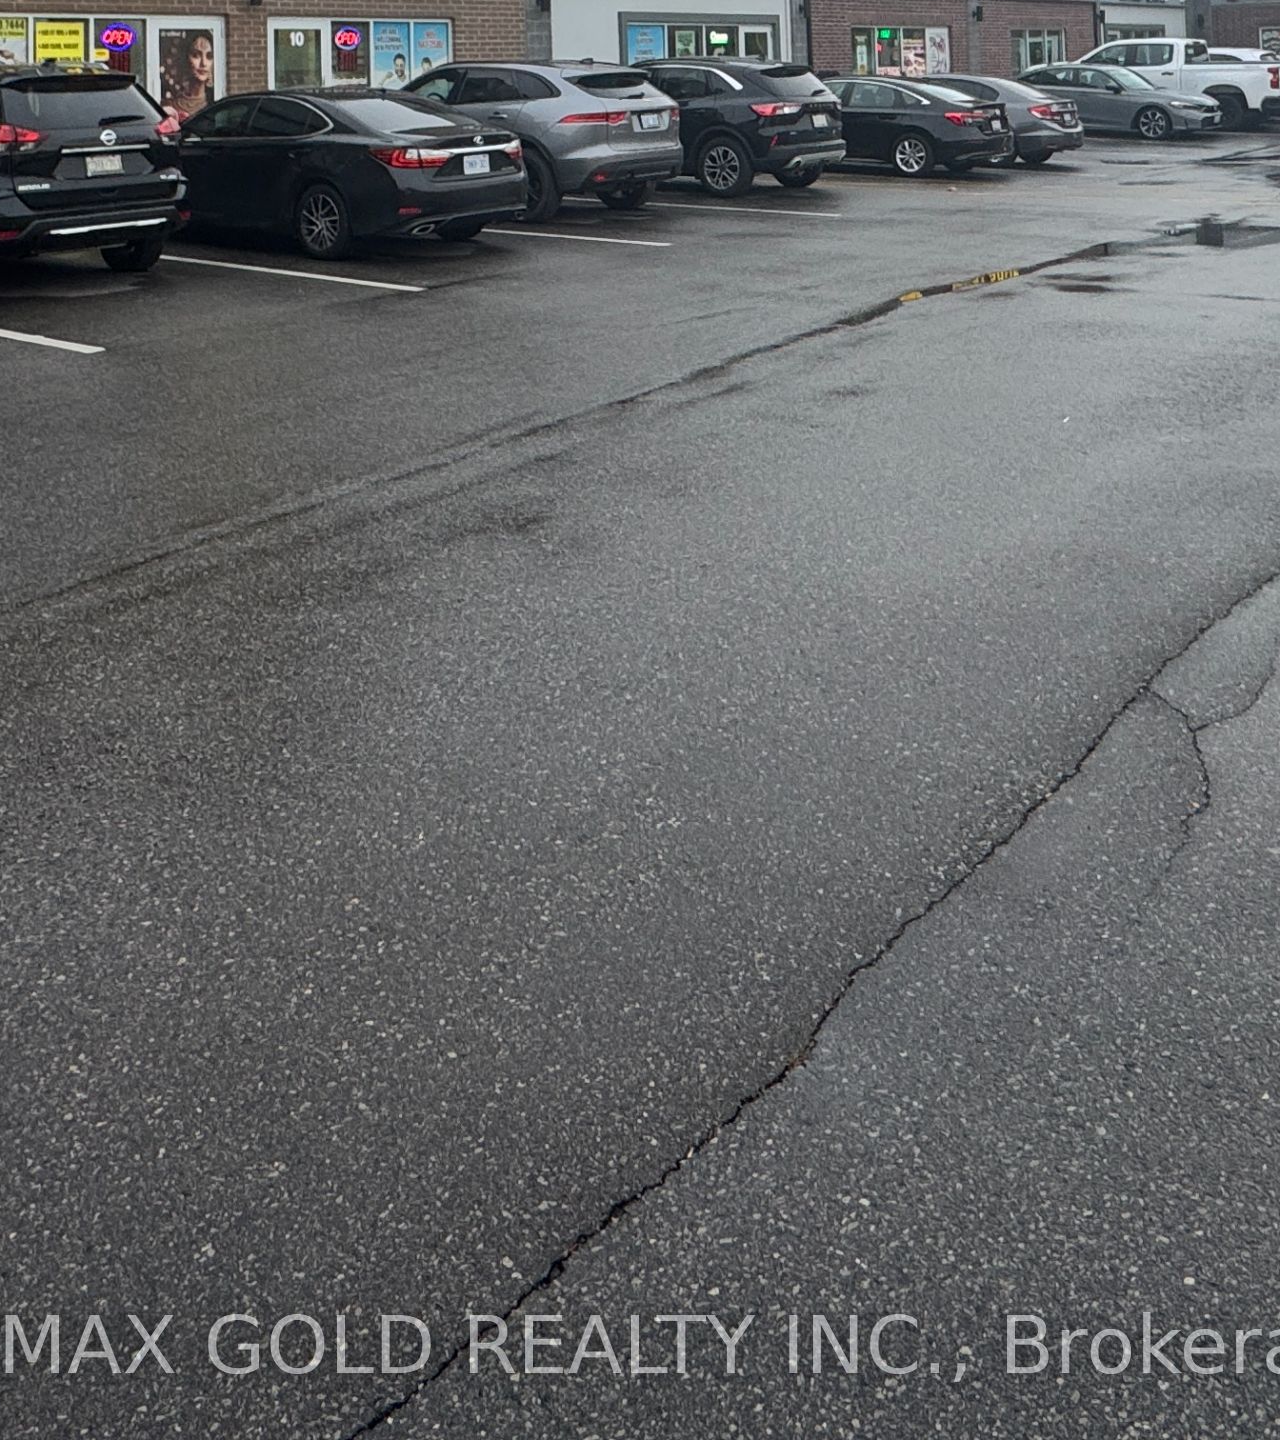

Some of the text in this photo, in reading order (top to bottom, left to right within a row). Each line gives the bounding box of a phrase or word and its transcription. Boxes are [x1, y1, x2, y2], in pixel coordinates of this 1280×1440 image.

[102, 30, 133, 45] OPEN
[289, 31, 304, 47] 10
[335, 31, 360, 46] OPEN
